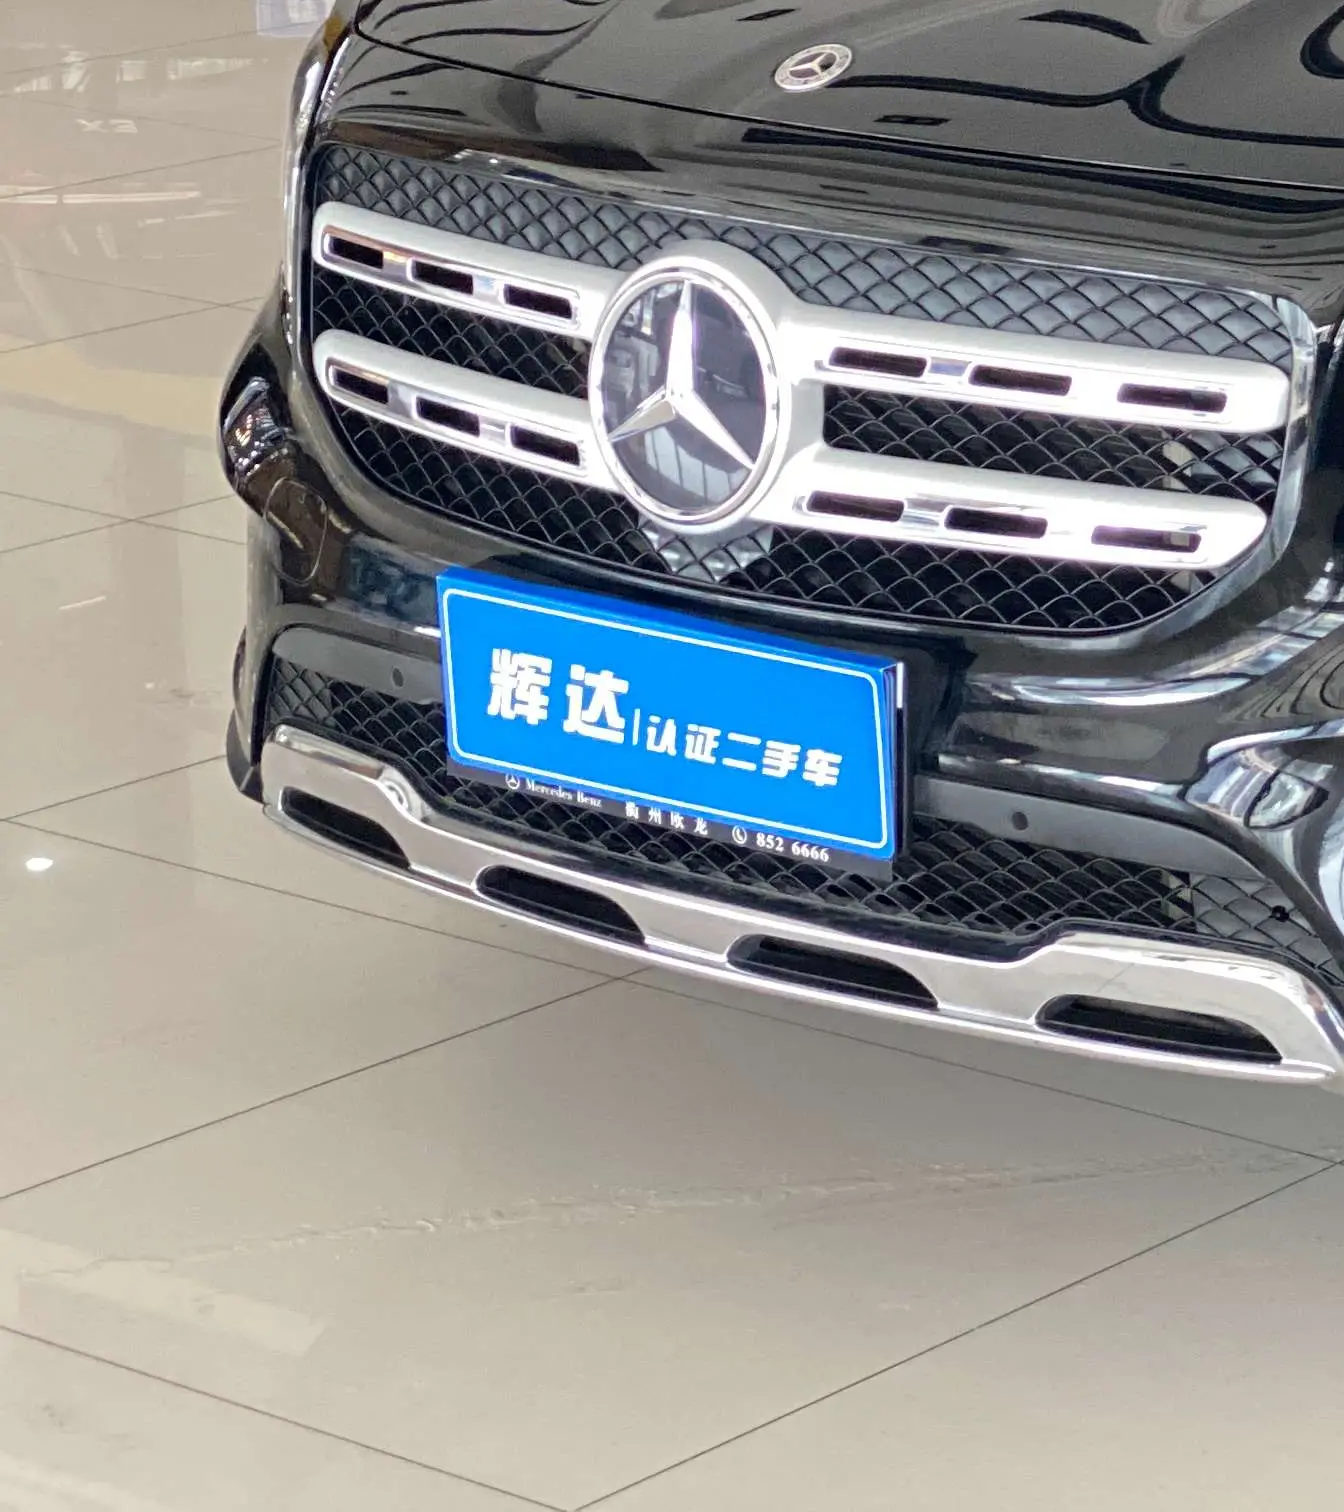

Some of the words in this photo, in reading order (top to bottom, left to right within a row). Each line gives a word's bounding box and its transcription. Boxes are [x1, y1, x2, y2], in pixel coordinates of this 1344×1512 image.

[487, 648, 629, 744] 辉达
[646, 715, 843, 787] 认证二手车
[526, 778, 573, 802] Mercedes
[577, 791, 602, 808] Benz
[756, 832, 784, 853] 852
[791, 841, 830, 863] 6666
